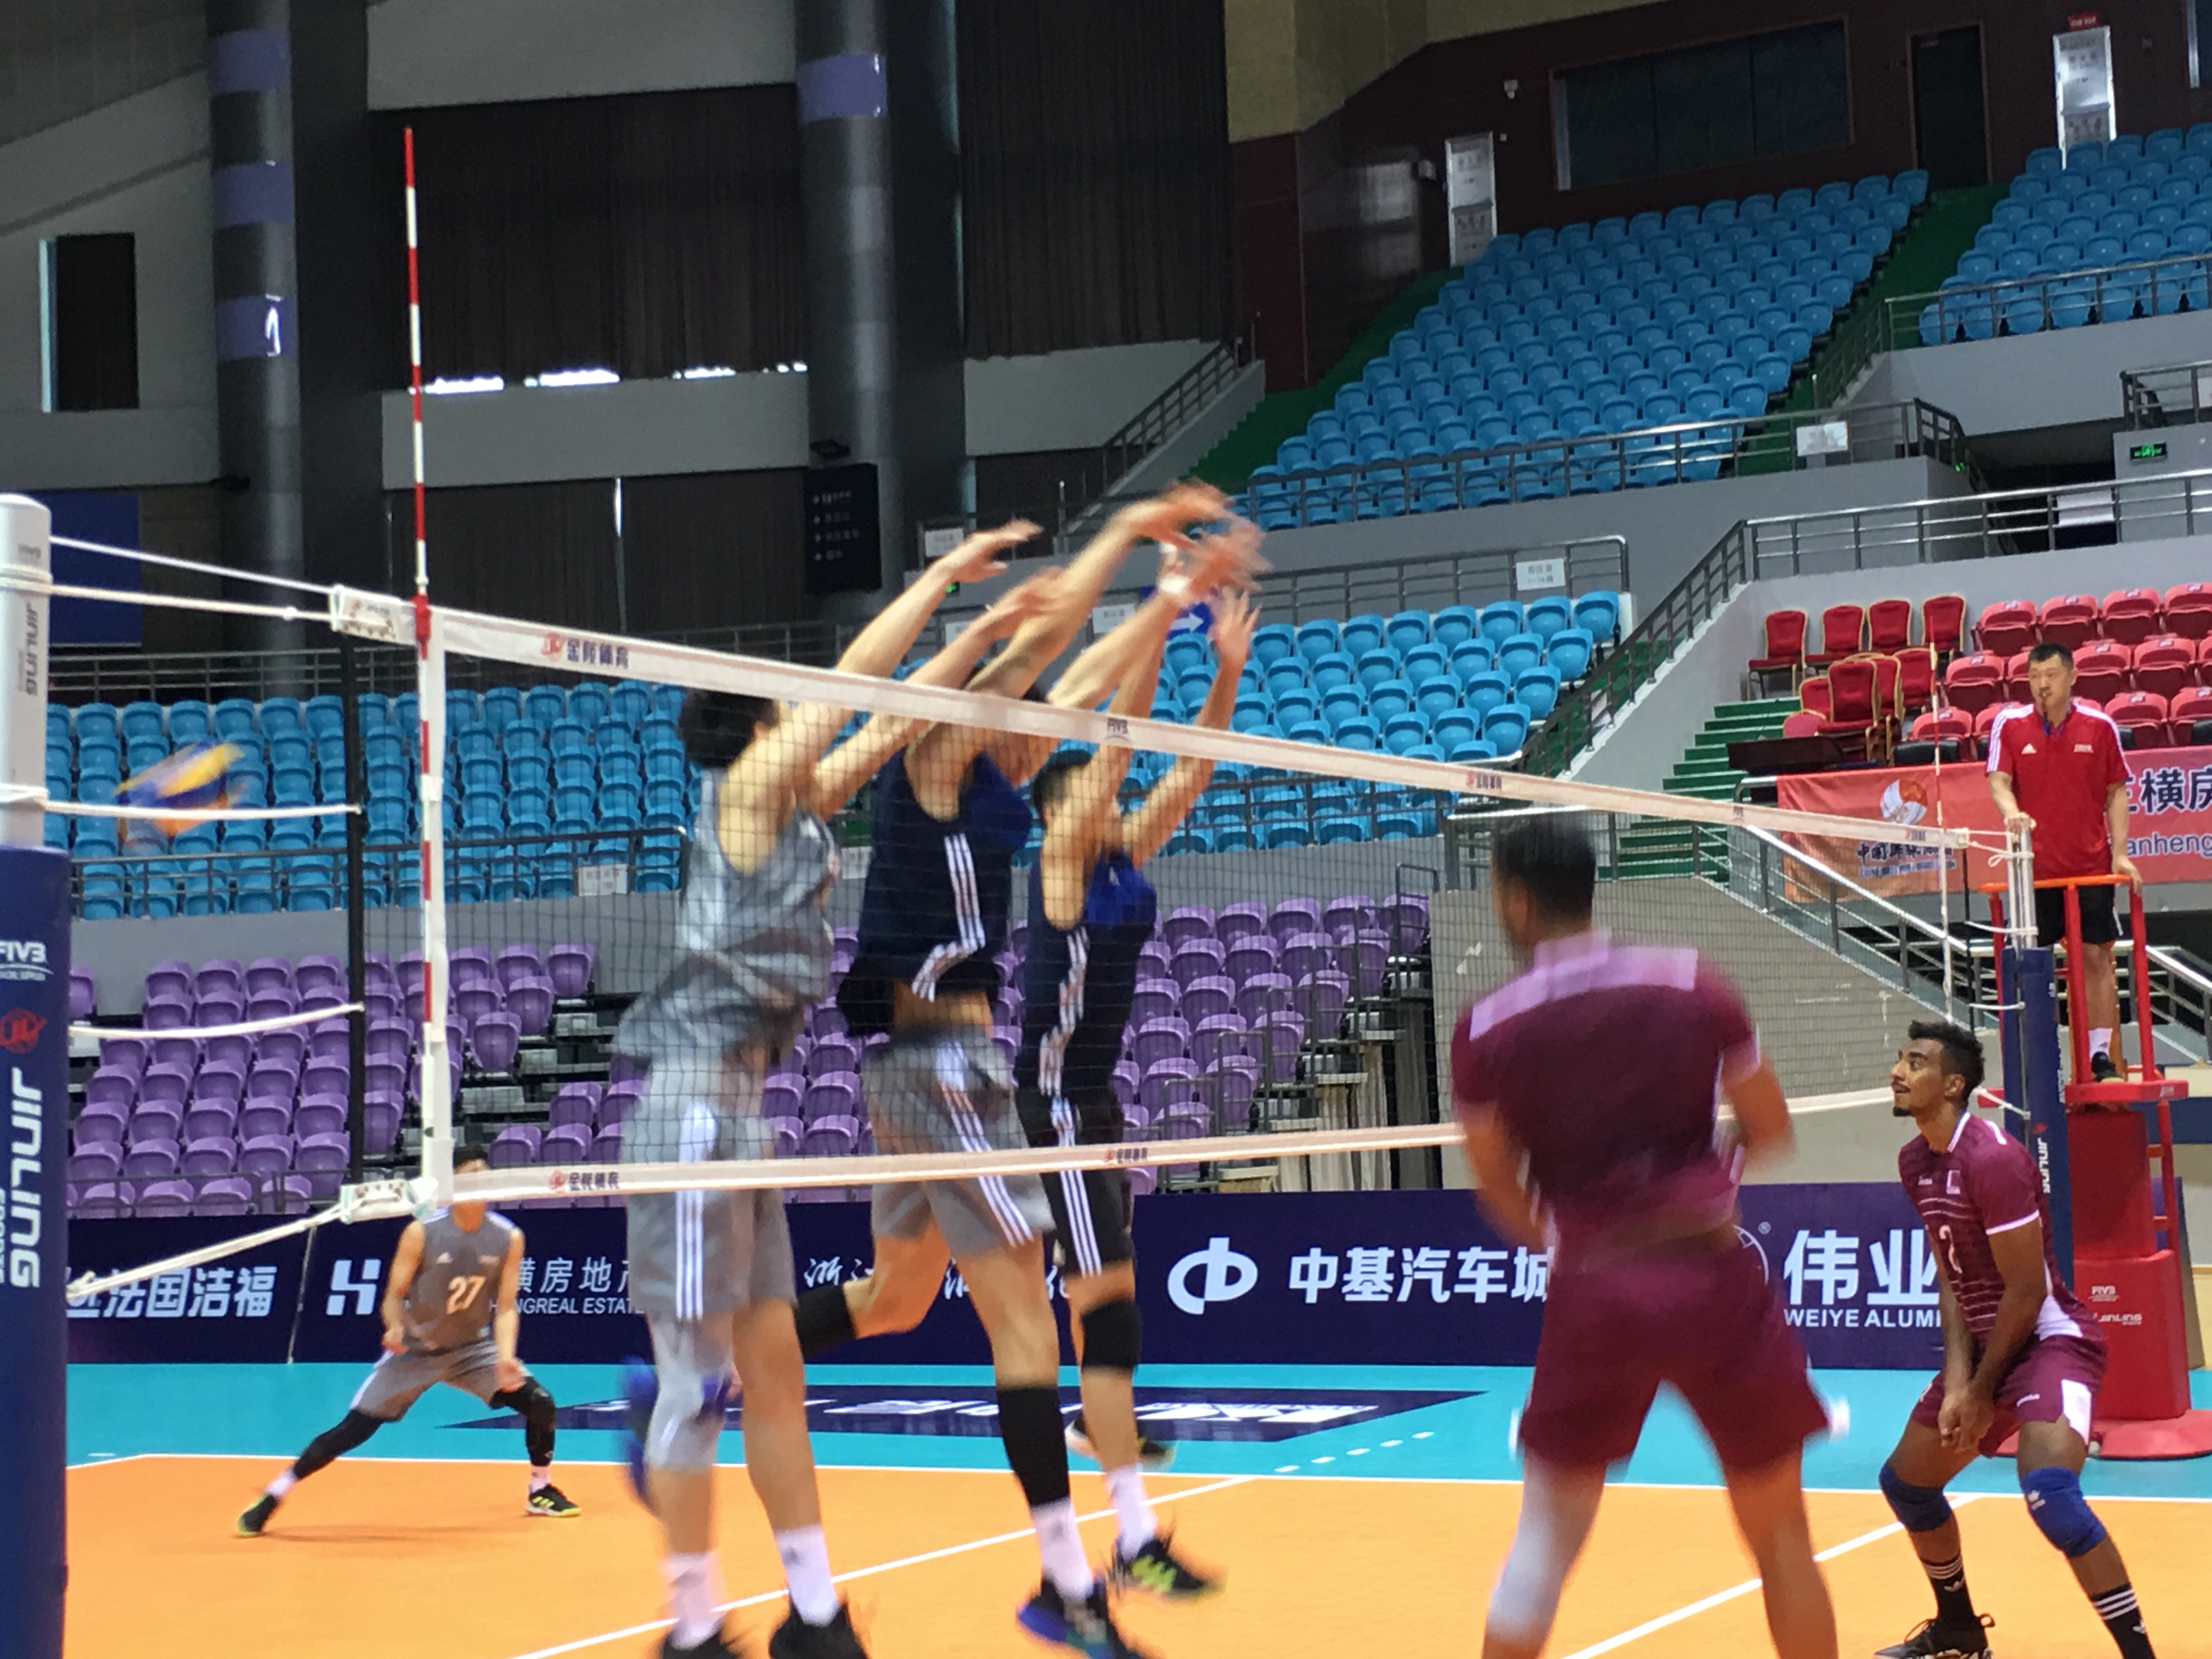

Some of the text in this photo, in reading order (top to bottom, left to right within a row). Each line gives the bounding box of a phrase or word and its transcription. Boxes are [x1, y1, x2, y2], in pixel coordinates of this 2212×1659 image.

[10, 1066, 42, 1288] JINLING
[1289, 1246, 1555, 1304] 中基汽车城
[1783, 1229, 1940, 1306] 伟业
[446, 1275, 486, 1314] 27
[489, 1297, 579, 1314] HNGREAL
[1784, 1309, 1859, 1327] WEIYE
